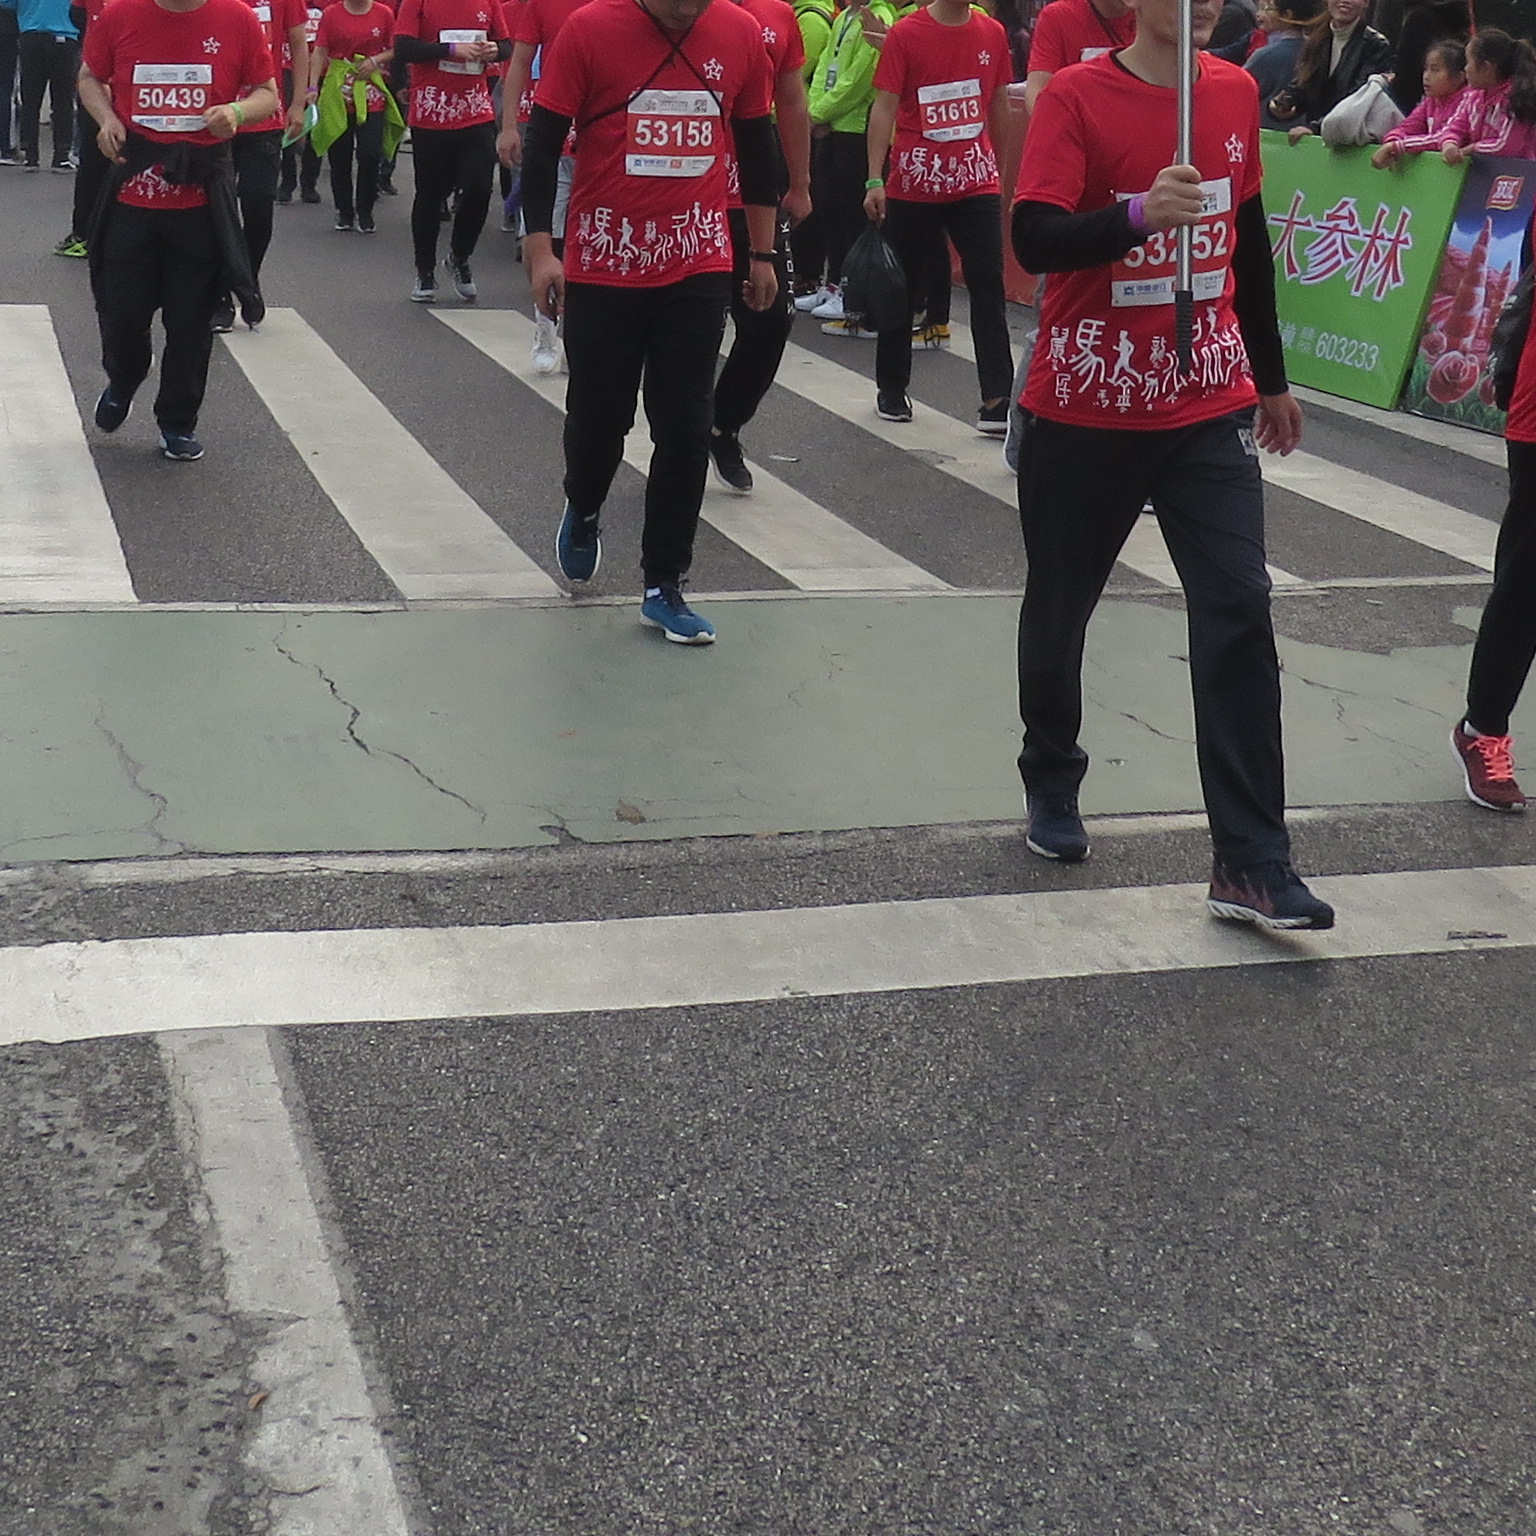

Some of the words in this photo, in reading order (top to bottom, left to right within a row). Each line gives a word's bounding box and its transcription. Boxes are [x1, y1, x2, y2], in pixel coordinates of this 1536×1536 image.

[138, 87, 207, 109] 50439
[926, 99, 980, 125] 51613
[634, 118, 714, 148] 53158
[1266, 188, 1413, 303] 大参林
[1315, 331, 1380, 371] 603233
